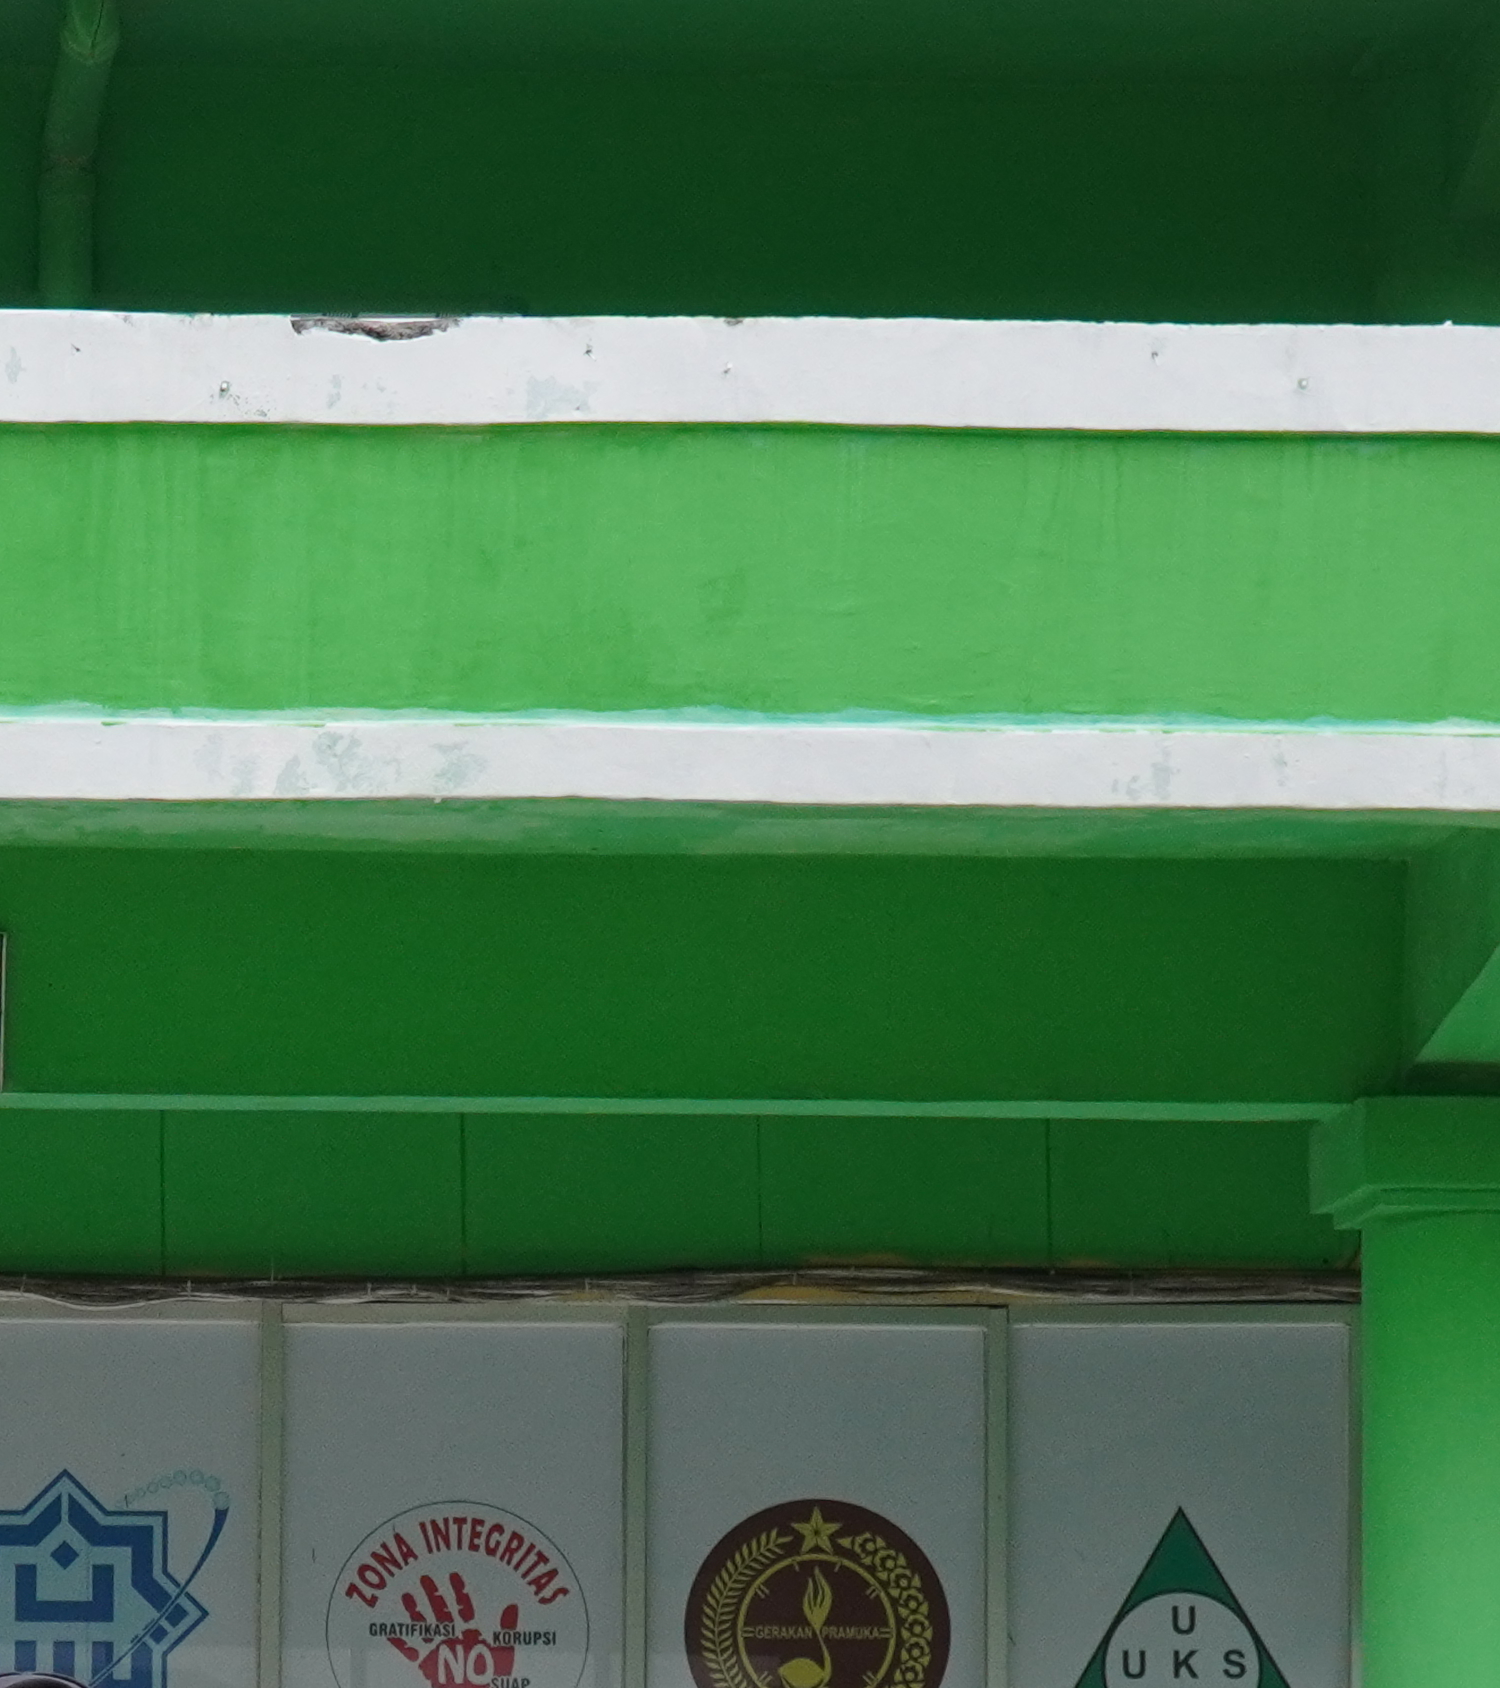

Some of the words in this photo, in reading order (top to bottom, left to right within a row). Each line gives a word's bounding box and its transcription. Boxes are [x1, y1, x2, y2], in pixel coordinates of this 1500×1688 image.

[345, 1532, 418, 1608] ZONA
[418, 1516, 570, 1605] INTEGRITAS
[369, 1622, 456, 1638] GRATIFIKASI
[492, 1630, 557, 1647] KORUPSI
[754, 1626, 813, 1640] GERAKAN
[821, 1626, 880, 1640] PRAMUKA
[437, 1643, 495, 1685] NO
